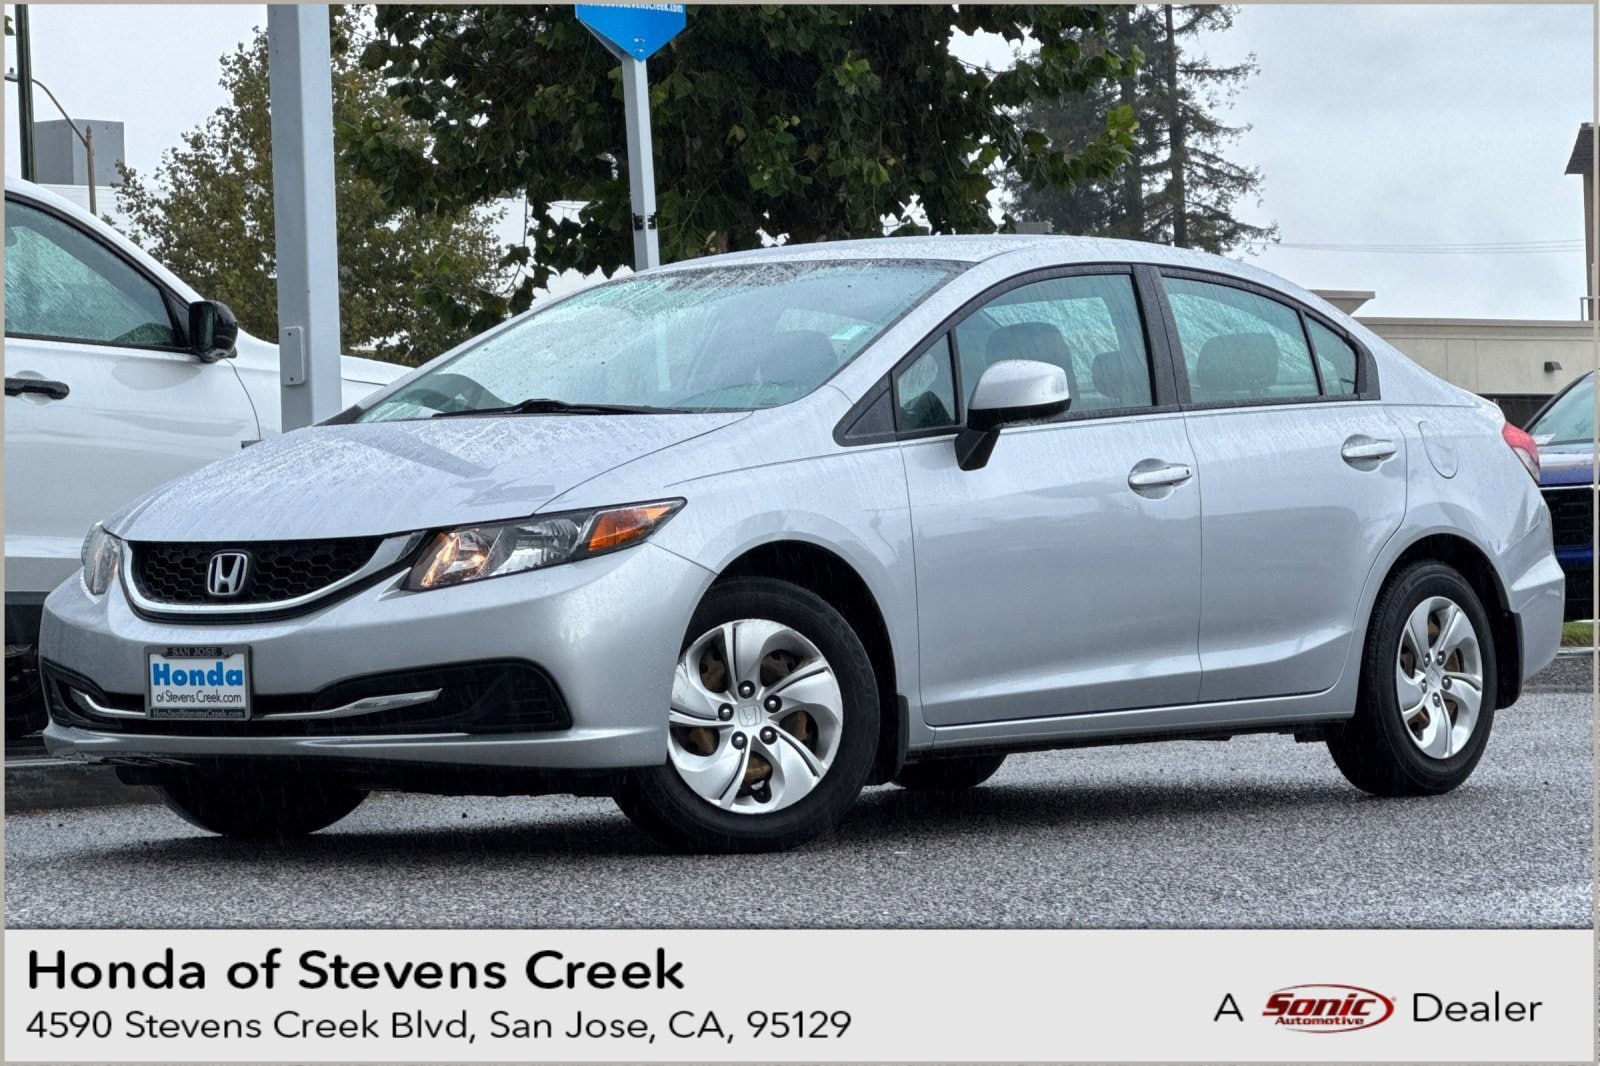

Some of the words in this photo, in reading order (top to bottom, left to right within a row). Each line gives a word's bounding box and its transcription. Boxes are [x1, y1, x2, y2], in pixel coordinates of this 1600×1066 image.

[172, 648, 190, 656] SAN
[193, 648, 218, 656] JOSE
[152, 661, 243, 686] Honda
[156, 692, 164, 703] of
